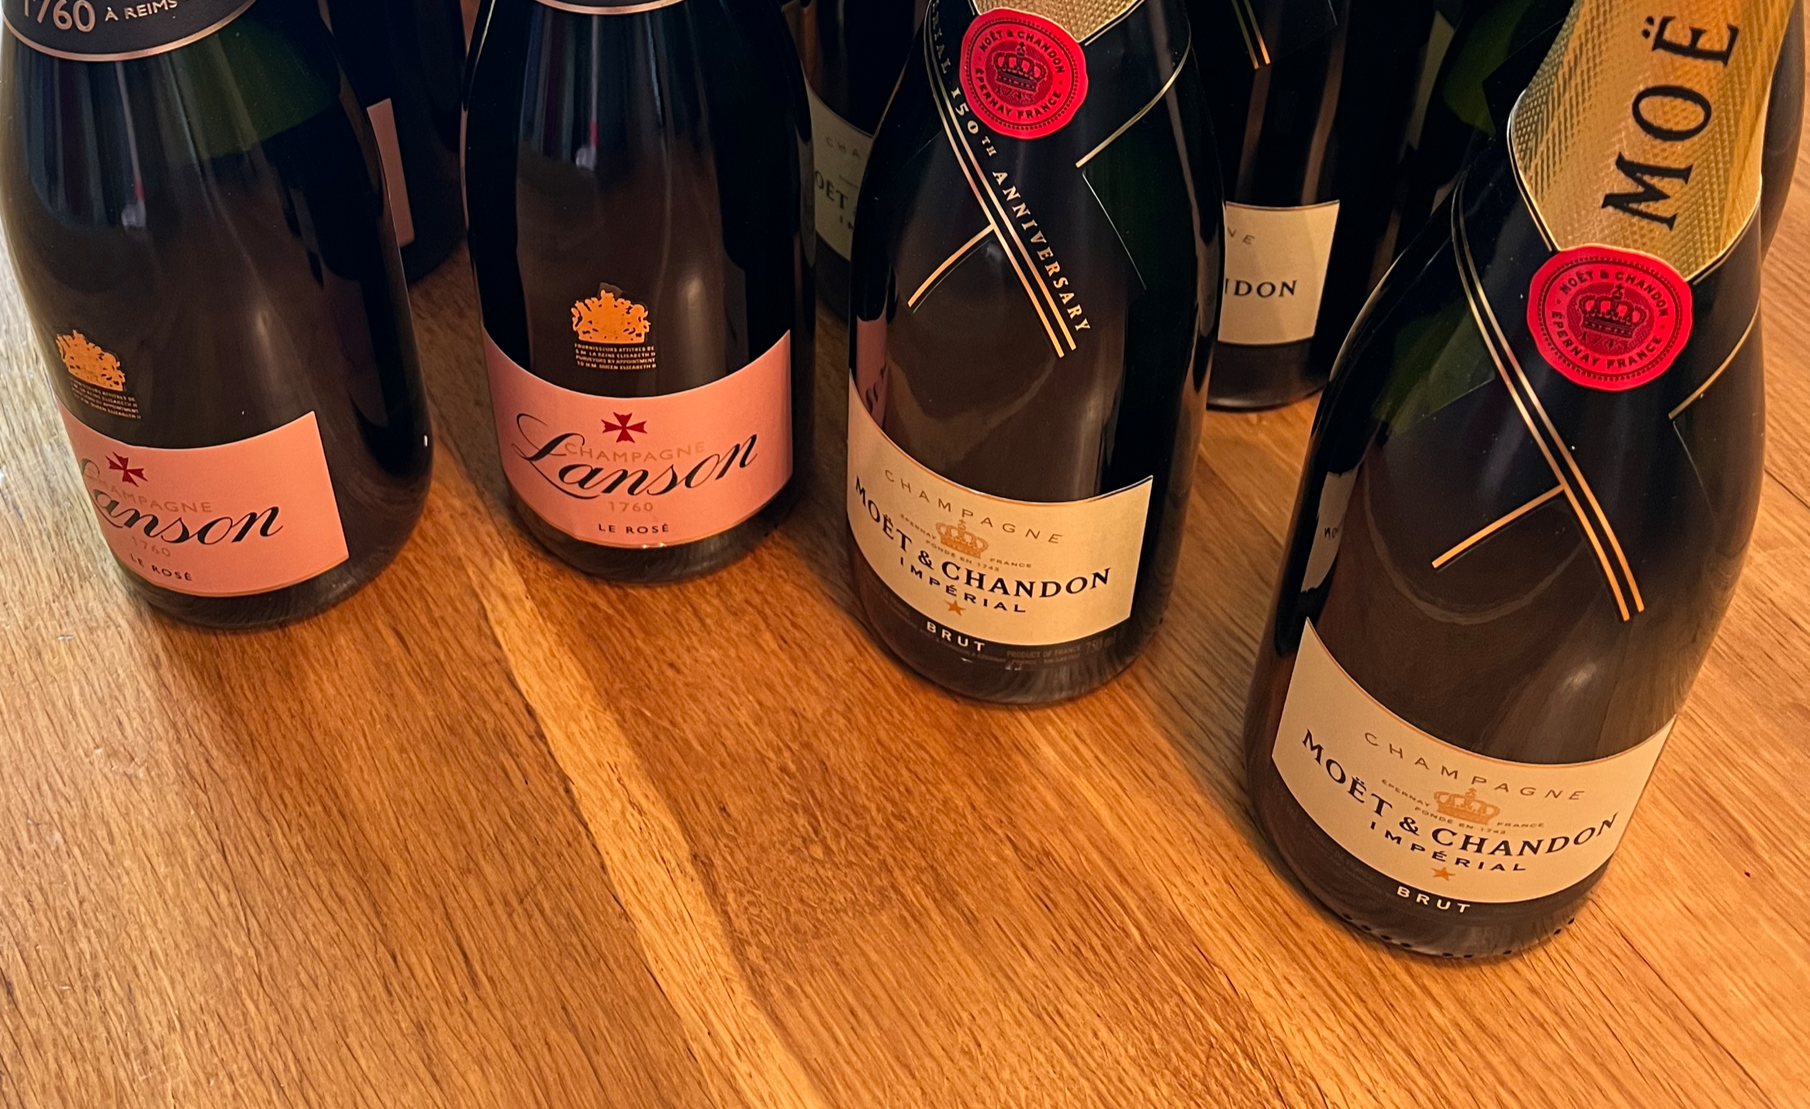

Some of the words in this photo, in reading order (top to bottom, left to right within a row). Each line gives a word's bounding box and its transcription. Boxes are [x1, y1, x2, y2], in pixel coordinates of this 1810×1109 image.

[105, 5, 119, 23] À
[1017, 30, 1066, 74] CHANDON
[1017, 90, 1062, 120] FRANCE
[991, 168, 1092, 332] ANNIVERSARY
[1614, 271, 1669, 318] CHANDON
[1606, 334, 1663, 370] FRANCE
[511, 412, 758, 500] Lanson
[563, 440, 706, 463] CHAMPAGNE
[607, 501, 654, 513] 1760
[884, 468, 1064, 545] CHAMPAGNE
[598, 523, 616, 534] LE
[626, 522, 670, 534] ROSÉ
[855, 475, 913, 554] MOËT
[917, 549, 935, 570] &
[940, 567, 1112, 599] CHANDON
[130, 553, 145, 568] LE
[151, 563, 193, 582] ROSÉ
[990, 557, 1033, 569] FRANCE
[899, 556, 1027, 614] IMPÉRIAL
[925, 620, 987, 653] BRUT
[1363, 731, 1586, 802] CHAMPAGNE
[1301, 728, 1393, 818] MOËT
[1398, 815, 1421, 837] &
[1430, 810, 1619, 858] CHANDON
[1496, 821, 1545, 829] FRANCE
[1369, 819, 1528, 872] IMPÉRIAL
[1396, 885, 1472, 914] BRUT
